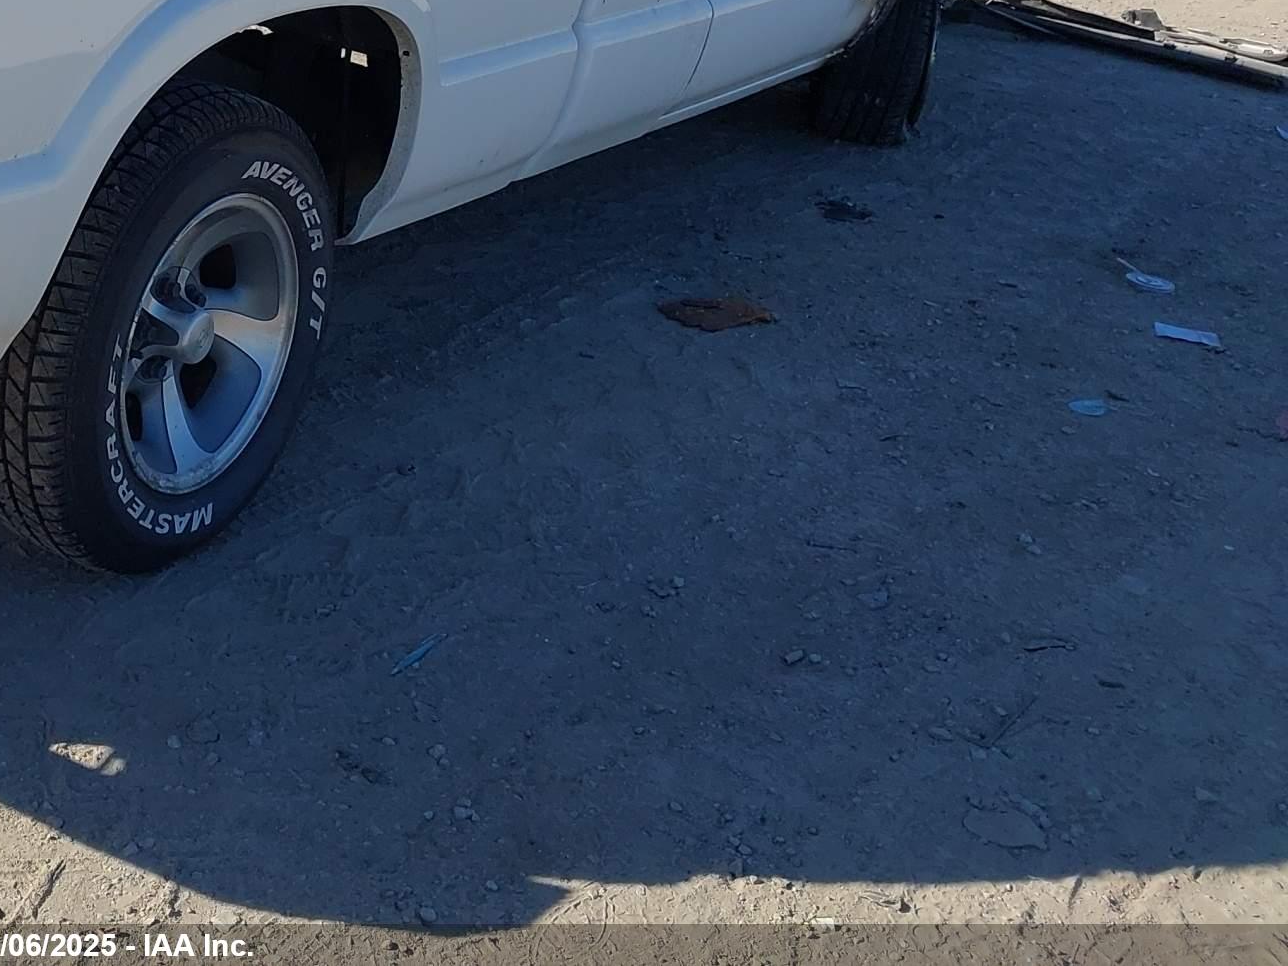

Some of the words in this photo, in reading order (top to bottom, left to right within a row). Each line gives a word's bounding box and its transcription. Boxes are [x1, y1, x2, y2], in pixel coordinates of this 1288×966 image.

[240, 160, 325, 252] AVENGER
[309, 266, 327, 341] G/T
[105, 333, 214, 535] MASTERCRAFT
